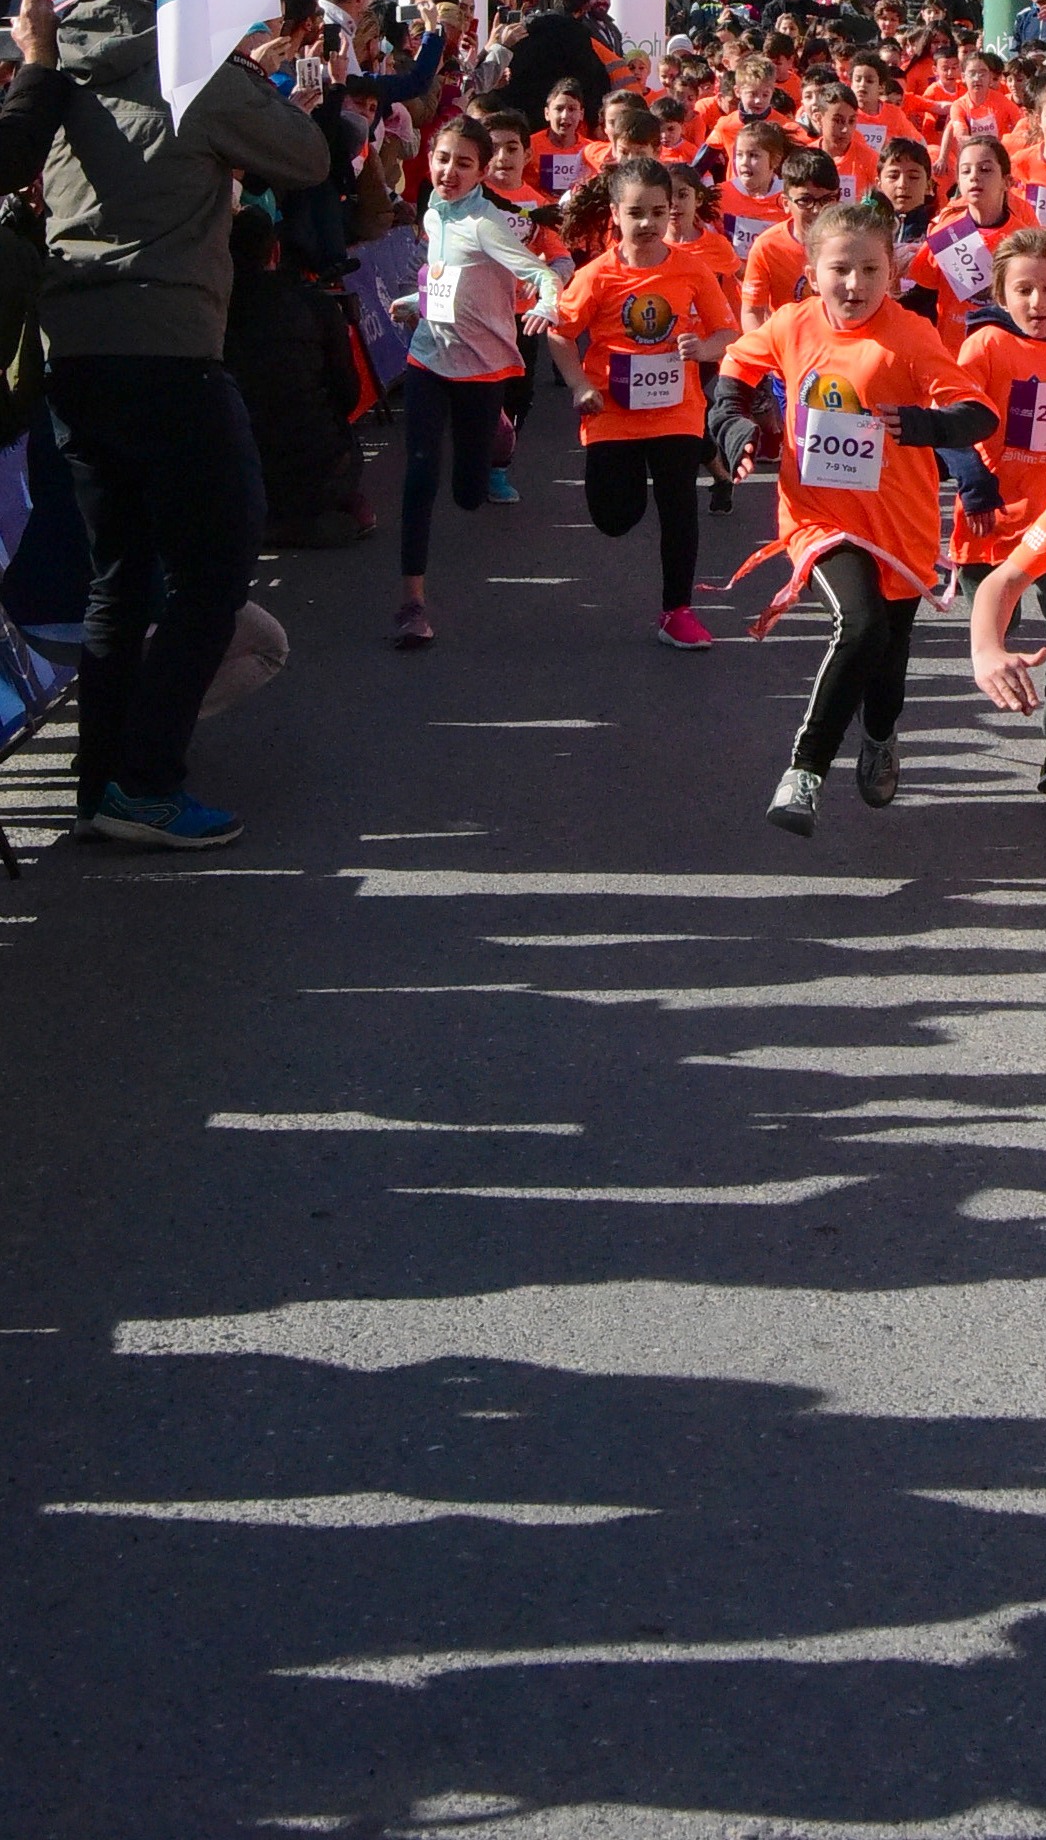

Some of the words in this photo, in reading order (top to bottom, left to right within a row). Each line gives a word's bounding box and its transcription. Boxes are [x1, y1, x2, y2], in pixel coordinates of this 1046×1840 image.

[954, 243, 985, 286] 2072
[632, 369, 679, 387] 2095
[807, 434, 875, 459] 2002
[825, 462, 840, 471] 7-9
